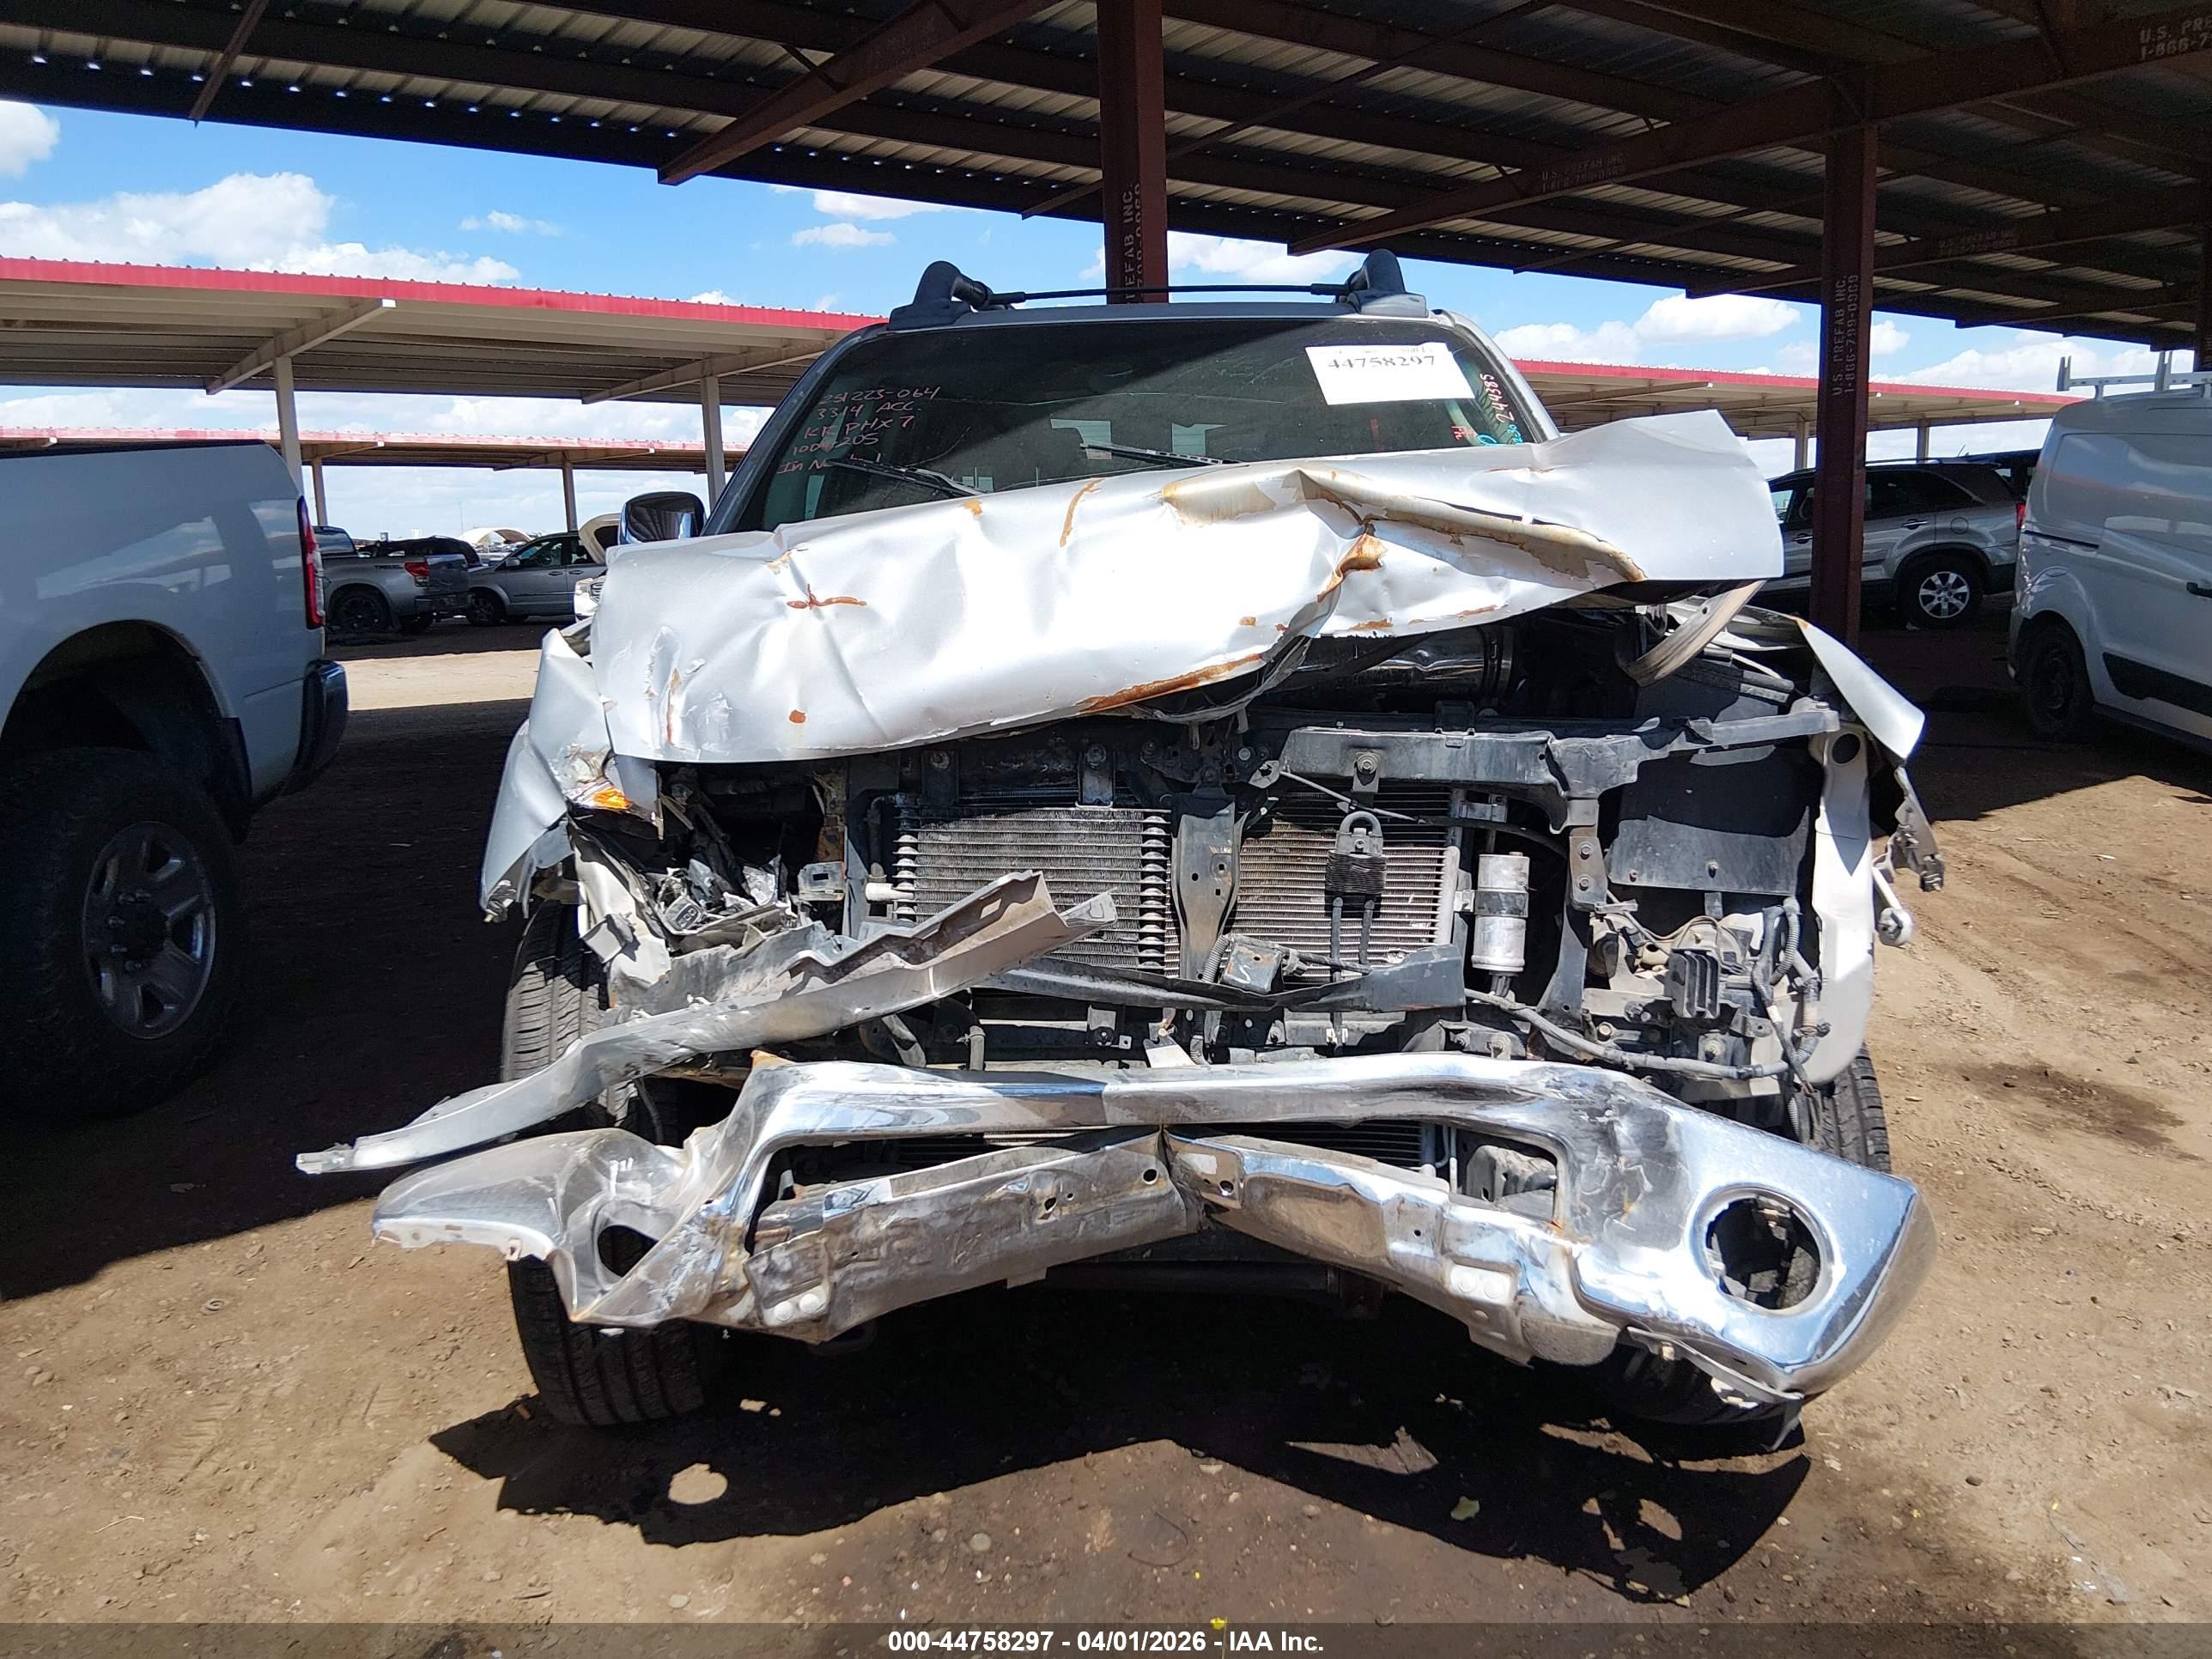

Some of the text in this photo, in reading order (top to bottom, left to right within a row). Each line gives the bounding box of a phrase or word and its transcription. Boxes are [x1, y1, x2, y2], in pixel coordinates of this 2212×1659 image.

[2139, 26, 2172, 44] U.S.
[1832, 275, 1848, 397] U.S. PREFAB INC.
[1328, 356, 1436, 369] 44758297
[1480, 373, 1515, 423] 244385
[817, 404, 864, 420] 3314
[845, 418, 893, 434] PHX
